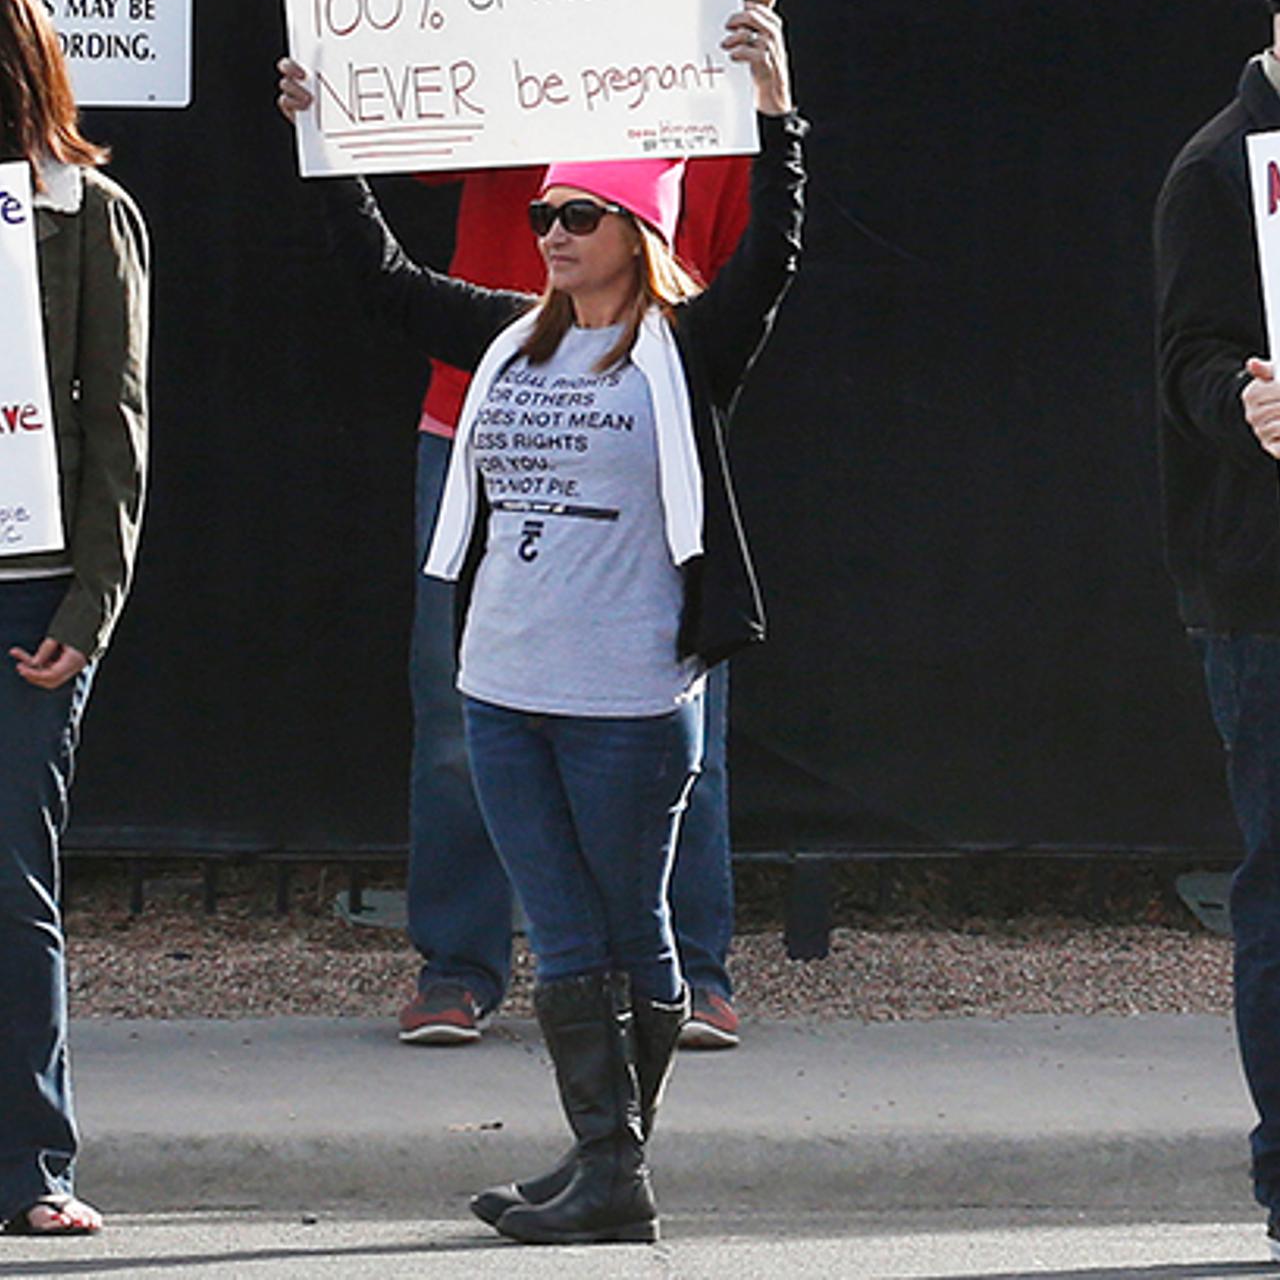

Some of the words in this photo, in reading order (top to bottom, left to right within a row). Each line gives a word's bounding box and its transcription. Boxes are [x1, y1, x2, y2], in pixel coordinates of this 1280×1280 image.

[315, 59, 485, 131] NEVER
[514, 58, 570, 110] be
[581, 54, 726, 111] pregnant
[515, 391, 595, 407] OTHERS
[520, 410, 563, 428] NOT
[567, 412, 634, 432] MEAN
[513, 432, 588, 452] RIGHTS
